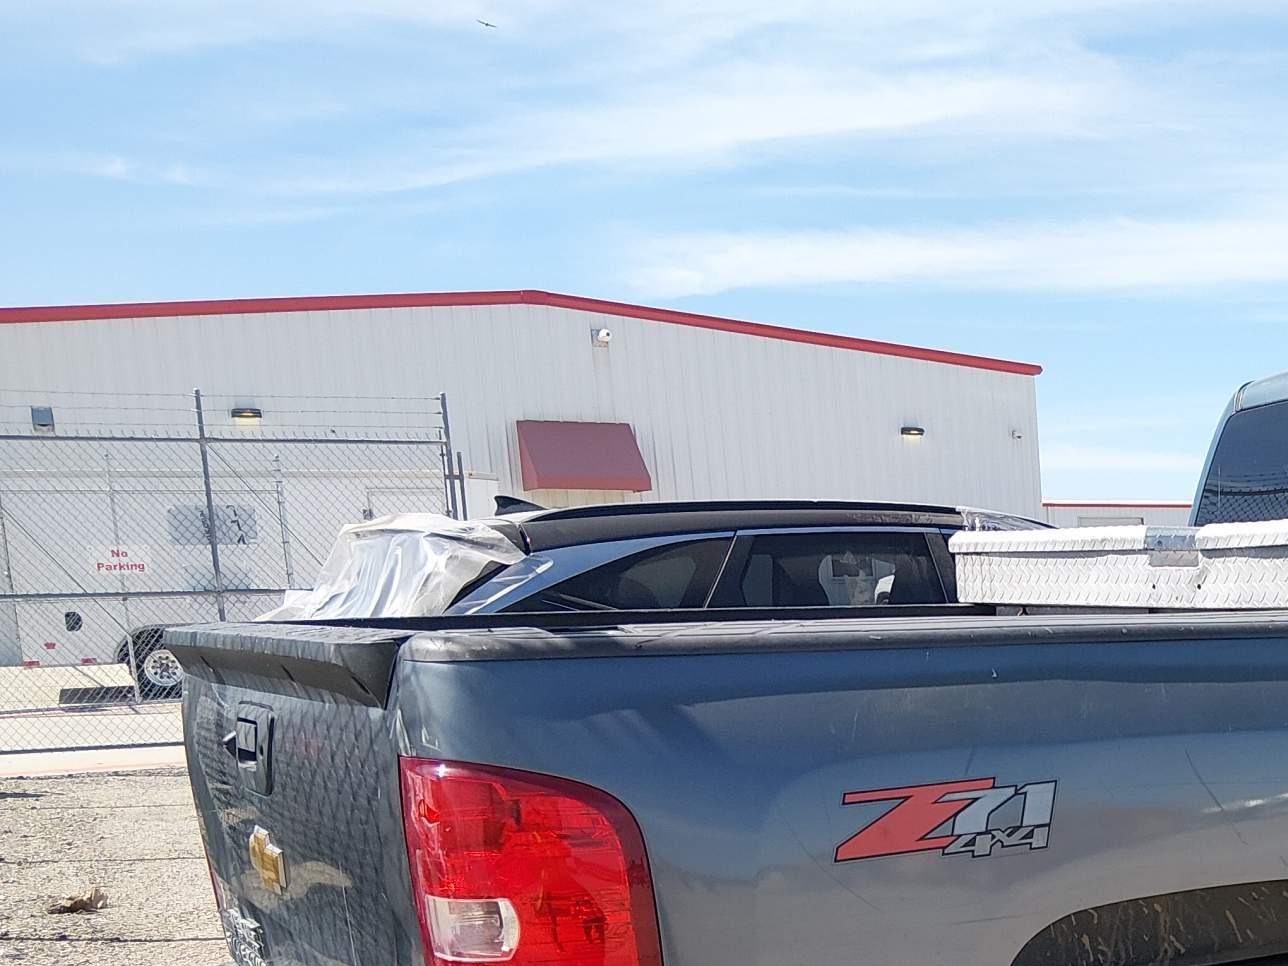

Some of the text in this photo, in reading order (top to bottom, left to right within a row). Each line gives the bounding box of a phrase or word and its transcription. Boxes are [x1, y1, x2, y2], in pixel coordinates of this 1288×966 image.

[110, 549, 128, 558] No
[96, 562, 145, 572] Parking
[834, 776, 1058, 863] Z71
